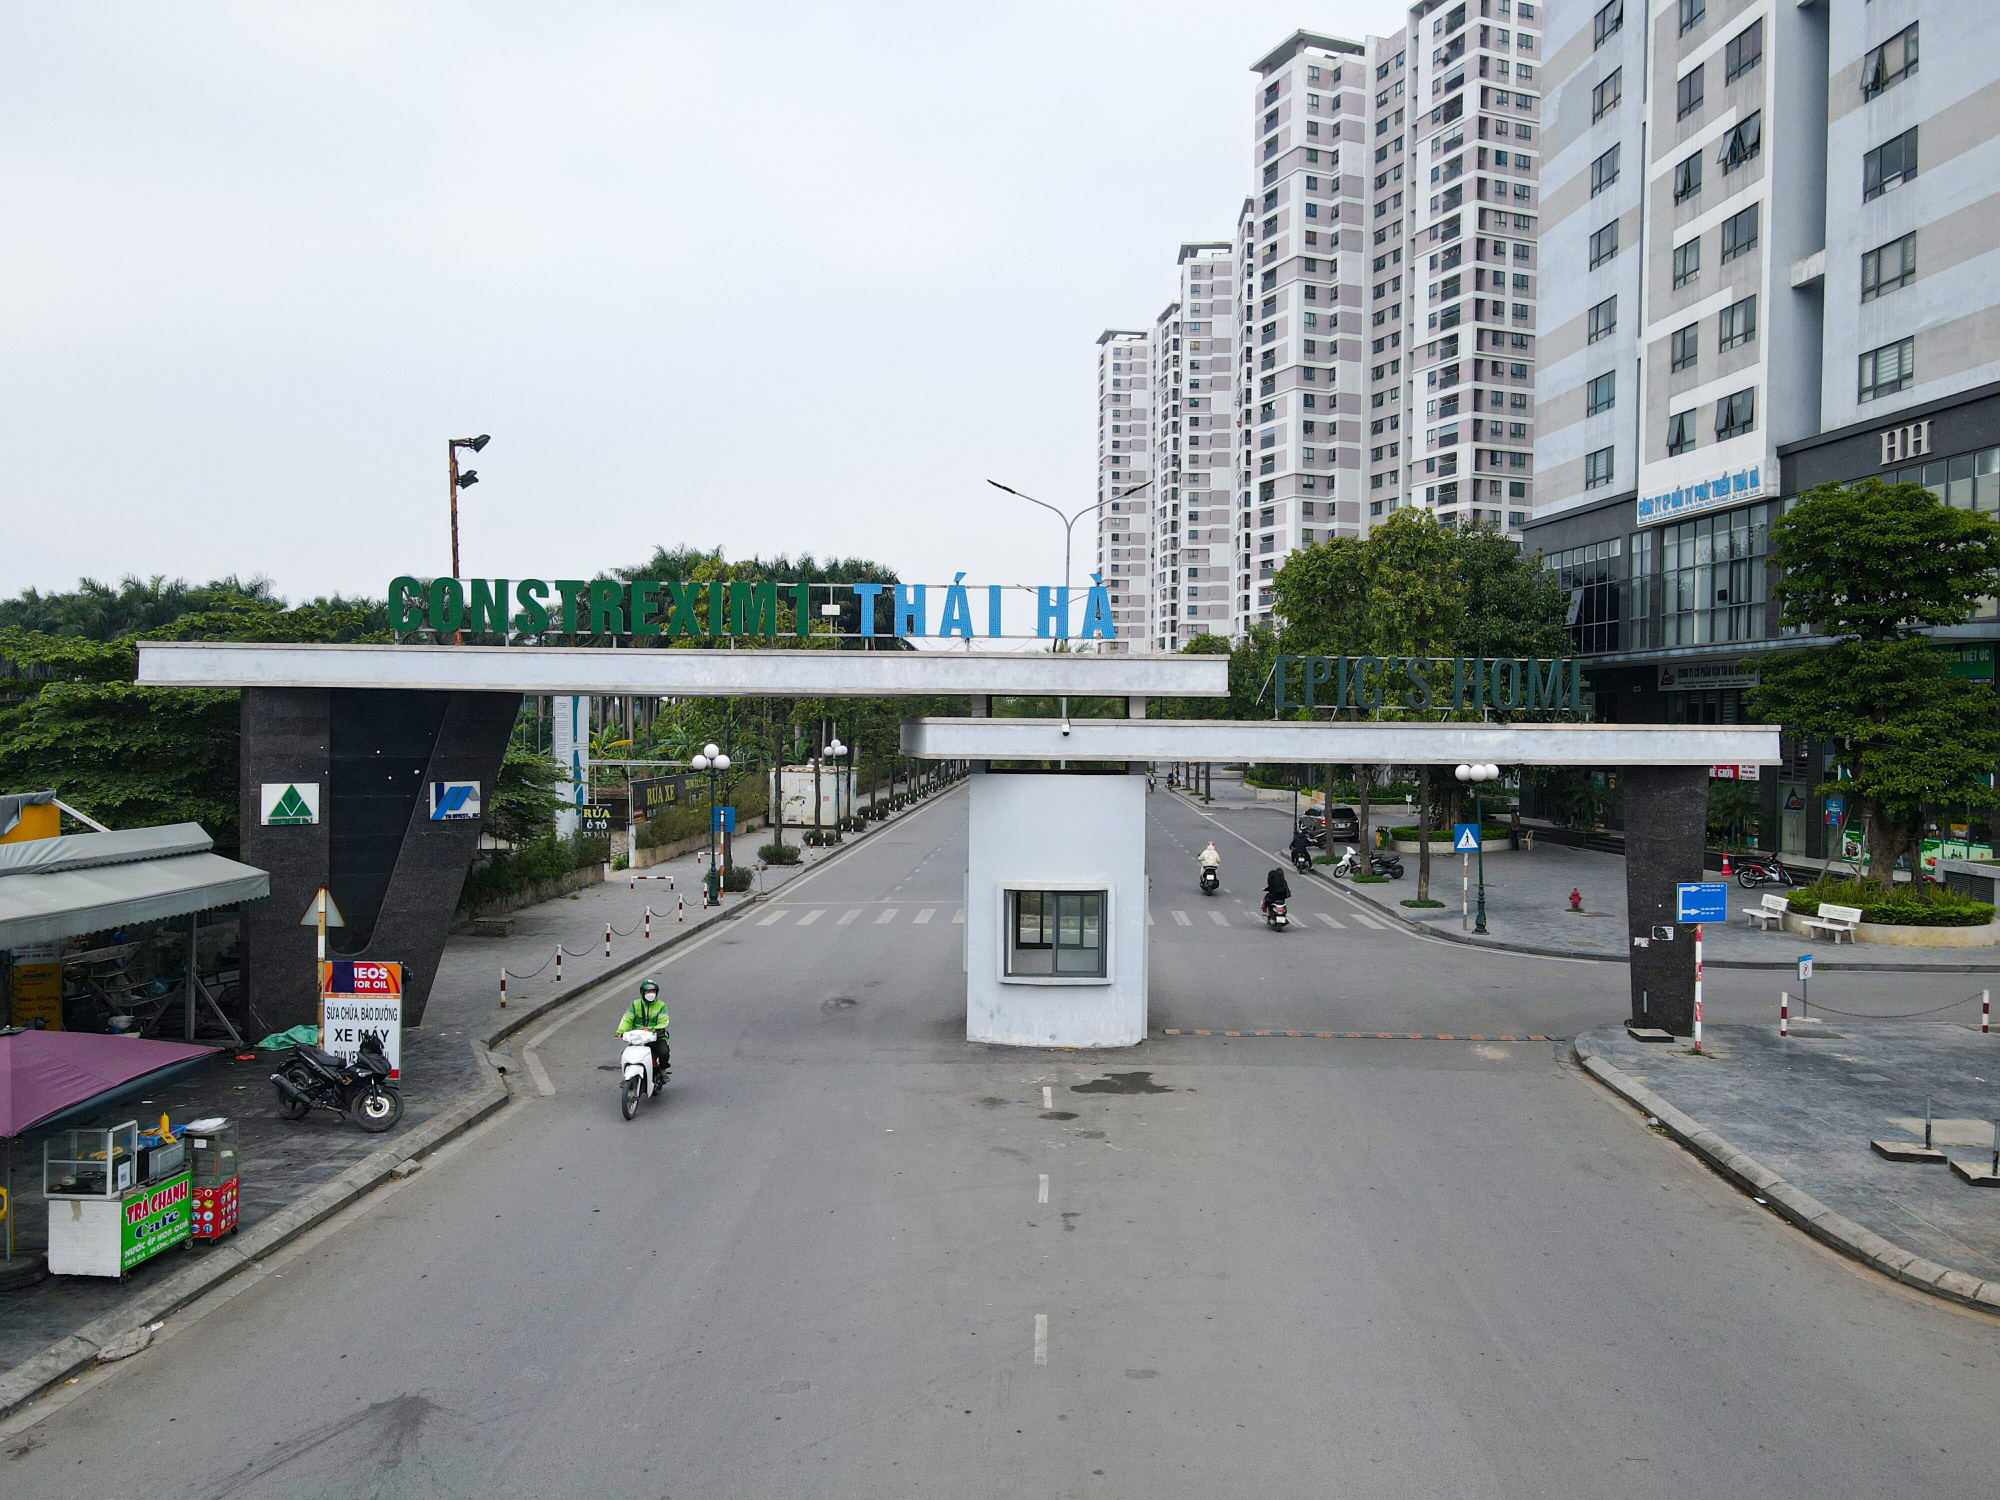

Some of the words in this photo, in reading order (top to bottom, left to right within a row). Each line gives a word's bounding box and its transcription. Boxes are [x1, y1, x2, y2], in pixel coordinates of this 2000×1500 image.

[1879, 420, 1934, 465] HH
[854, 572, 1001, 638] THÁI
[1037, 573, 1115, 639] HÀ
[1962, 649, 1977, 664] VIỆT
[1979, 647, 1990, 661] ÚC
[1275, 655, 1433, 710] EPIC'S
[1453, 658, 1594, 711] HOME
[647, 781, 663, 806] RỬA
[665, 785, 675, 802] XE
[583, 805, 611, 818] RỬA
[587, 819, 593, 829] Ô
[595, 819, 607, 829] TÔ
[373, 980, 387, 989] OIL
[326, 1002, 339, 1020] SỬA
[361, 1003, 374, 1021] BẢO
[375, 1005, 398, 1021] DƯỠNG
[335, 1028, 353, 1042] XE
[358, 1026, 389, 1042] MÁY
[126, 1192, 149, 1225] TRÀ
[150, 1179, 189, 1213] CHANH
[135, 1208, 180, 1239] Café
[124, 1241, 146, 1258] NƯỚC
[147, 1236, 156, 1246] ÉP
[174, 1218, 189, 1232] QUẢ
